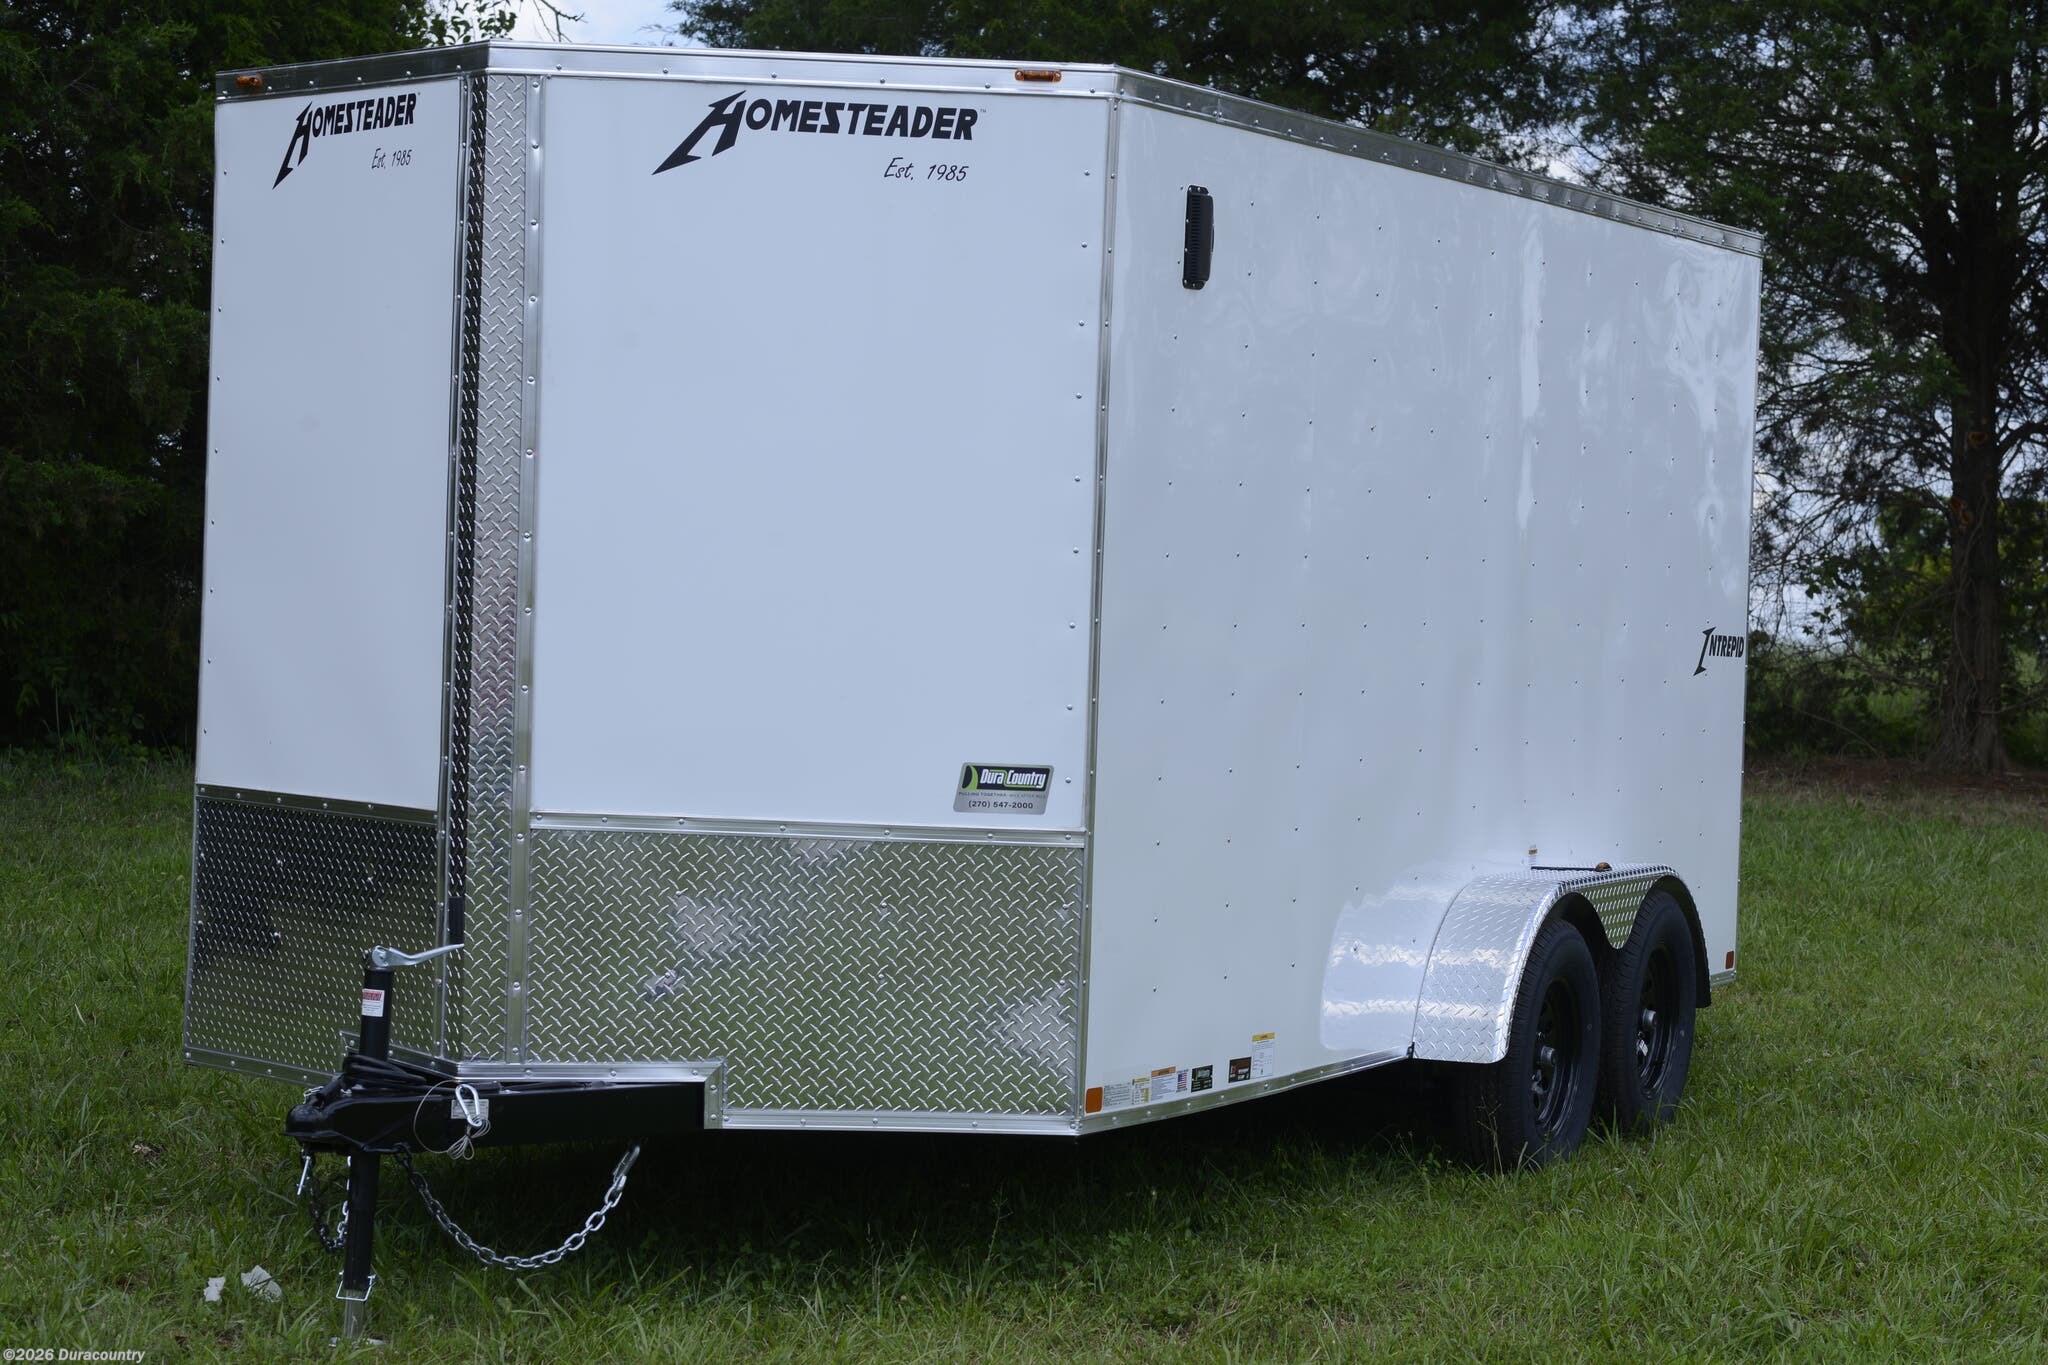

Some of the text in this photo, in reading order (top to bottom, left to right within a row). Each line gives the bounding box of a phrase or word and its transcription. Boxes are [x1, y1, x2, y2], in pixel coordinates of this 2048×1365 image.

[272, 92, 417, 190] HOMESTEADER
[652, 90, 978, 175] HOMESTEADER
[372, 148, 412, 169] Est. 1985
[884, 157, 969, 181] Est. 1985
[1693, 626, 1745, 676] INTREPID
[980, 769, 1046, 788] Dura Country
[968, 800, 1033, 809] (270) 547-2000
